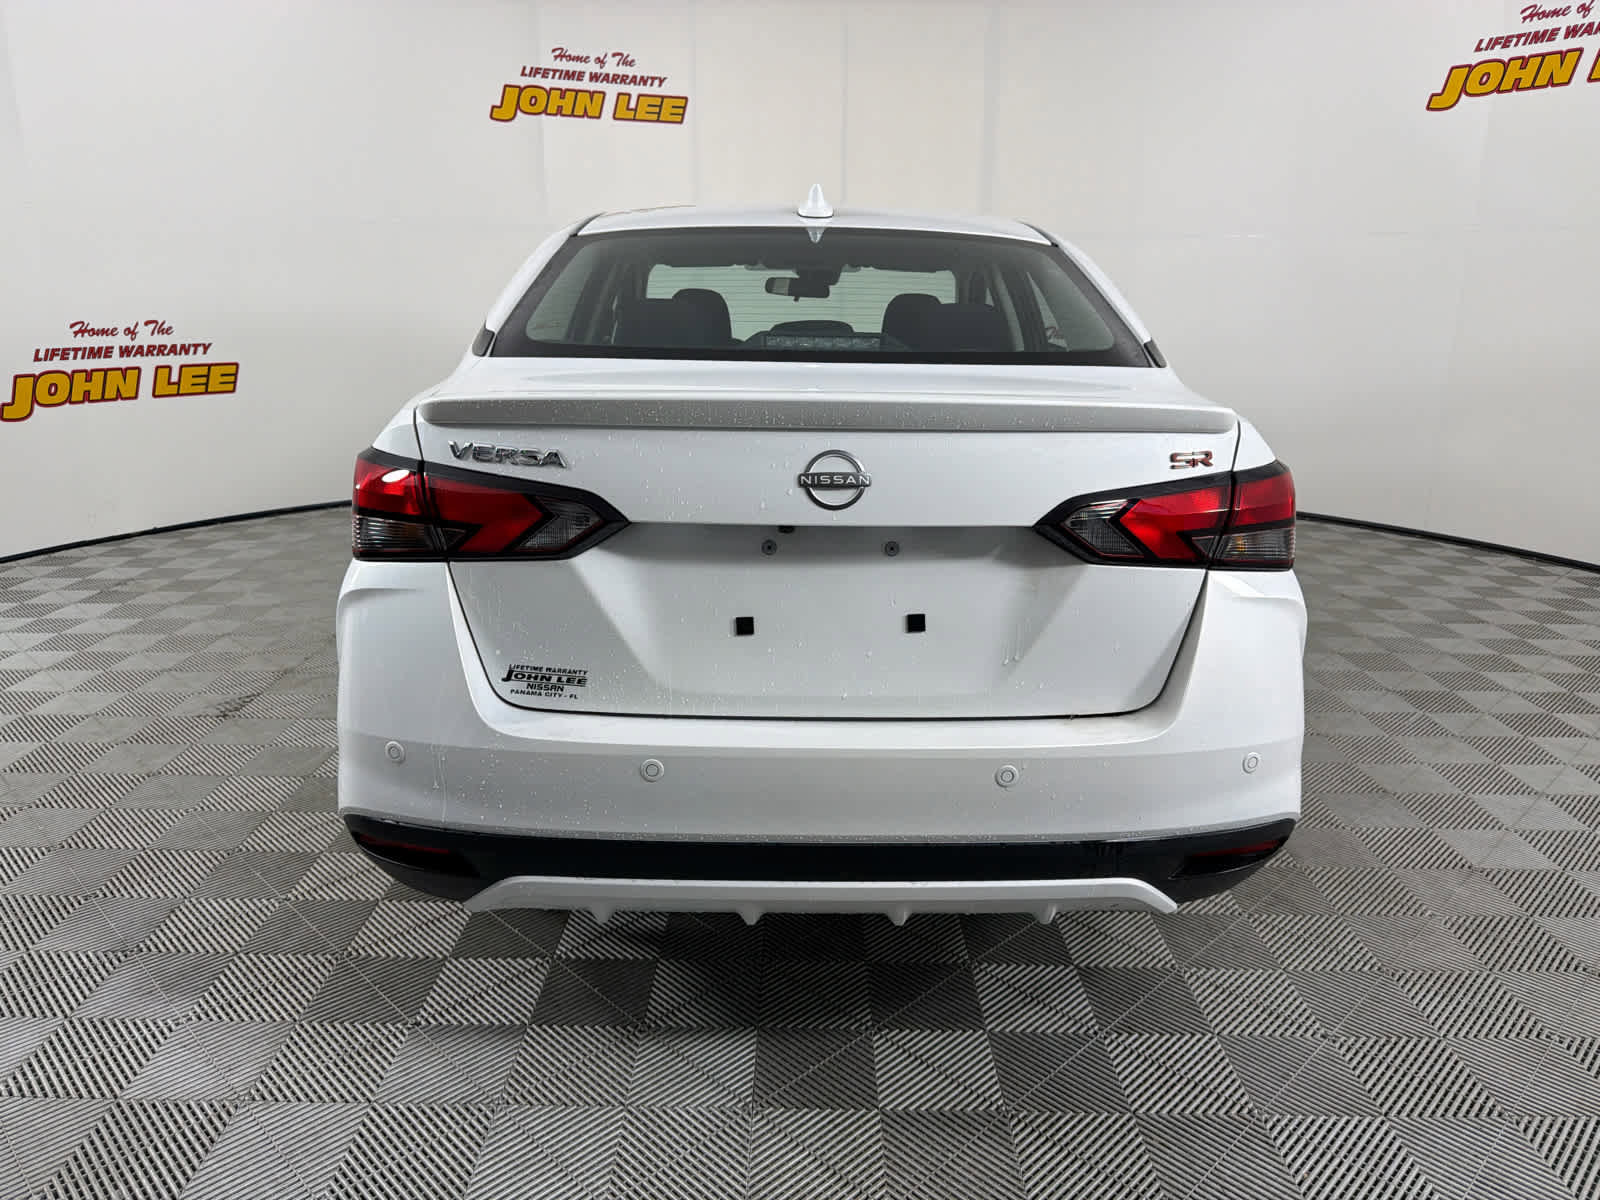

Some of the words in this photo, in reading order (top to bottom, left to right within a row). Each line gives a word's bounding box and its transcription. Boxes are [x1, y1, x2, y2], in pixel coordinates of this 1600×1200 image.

[1520, 4, 1572, 24] Home
[1577, 0, 1595, 18] of
[1473, 27, 1561, 53] LIFETIME
[551, 47, 590, 64] Home
[594, 52, 608, 68] of
[611, 52, 636, 68] The
[520, 65, 585, 82] LIFETIME
[588, 71, 667, 88] WARRANTY
[1426, 47, 1584, 112] JOHN
[489, 84, 606, 122] JOHN
[612, 92, 689, 125] LEE
[69, 320, 119, 338] Home
[124, 321, 139, 341] of
[144, 319, 174, 337] The
[33, 345, 114, 362] LIFETIME
[118, 342, 213, 359] WARRANTY
[0, 366, 141, 422] JOHN
[152, 362, 239, 398] LEE
[448, 440, 567, 468] VERSA
[1169, 450, 1214, 469] SR
[800, 474, 870, 486] NISSAN
[501, 669, 553, 682] JOHN
[556, 675, 588, 686] LEE
[509, 663, 544, 673] LIFETIME
[545, 666, 588, 676] WARRANTY
[510, 688, 542, 698] PANAMA
[544, 690, 563, 699] CITY
[526, 682, 565, 693] NISSAN
